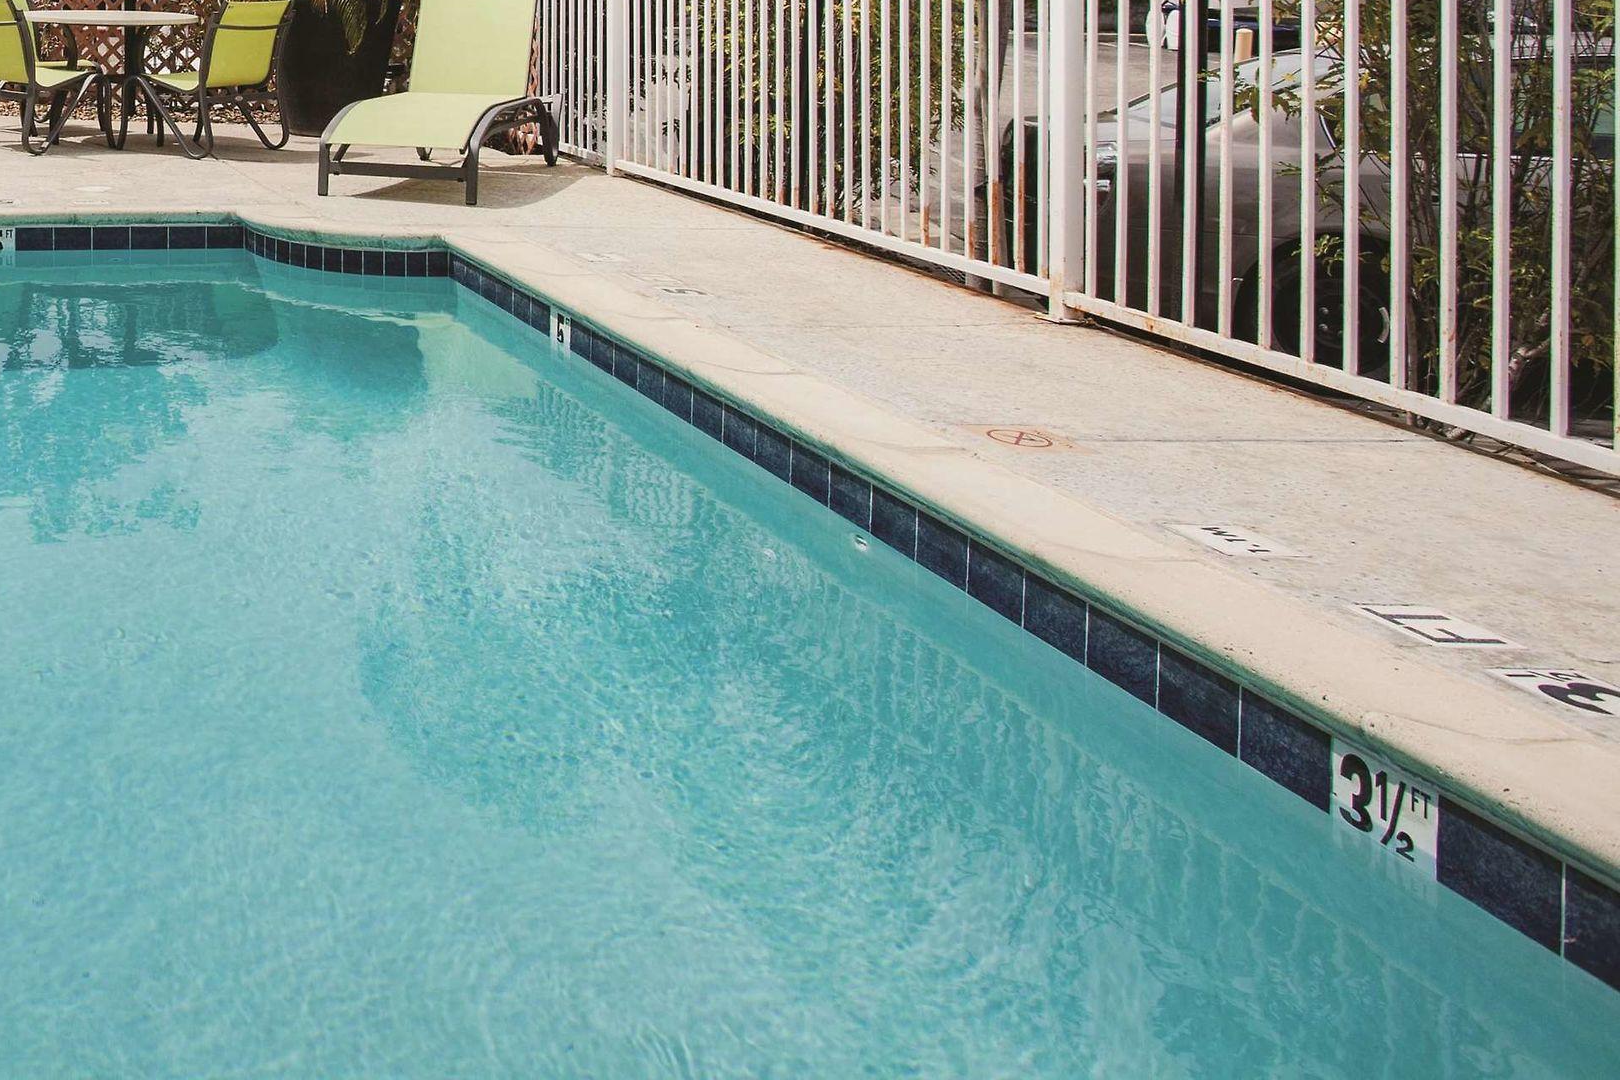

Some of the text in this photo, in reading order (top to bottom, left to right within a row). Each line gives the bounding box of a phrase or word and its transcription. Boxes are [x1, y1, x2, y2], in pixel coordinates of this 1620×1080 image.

[6, 229, 14, 239] FT
[557, 313, 564, 344] 5
[1361, 607, 1508, 645] FT
[1411, 786, 1431, 819] FT
